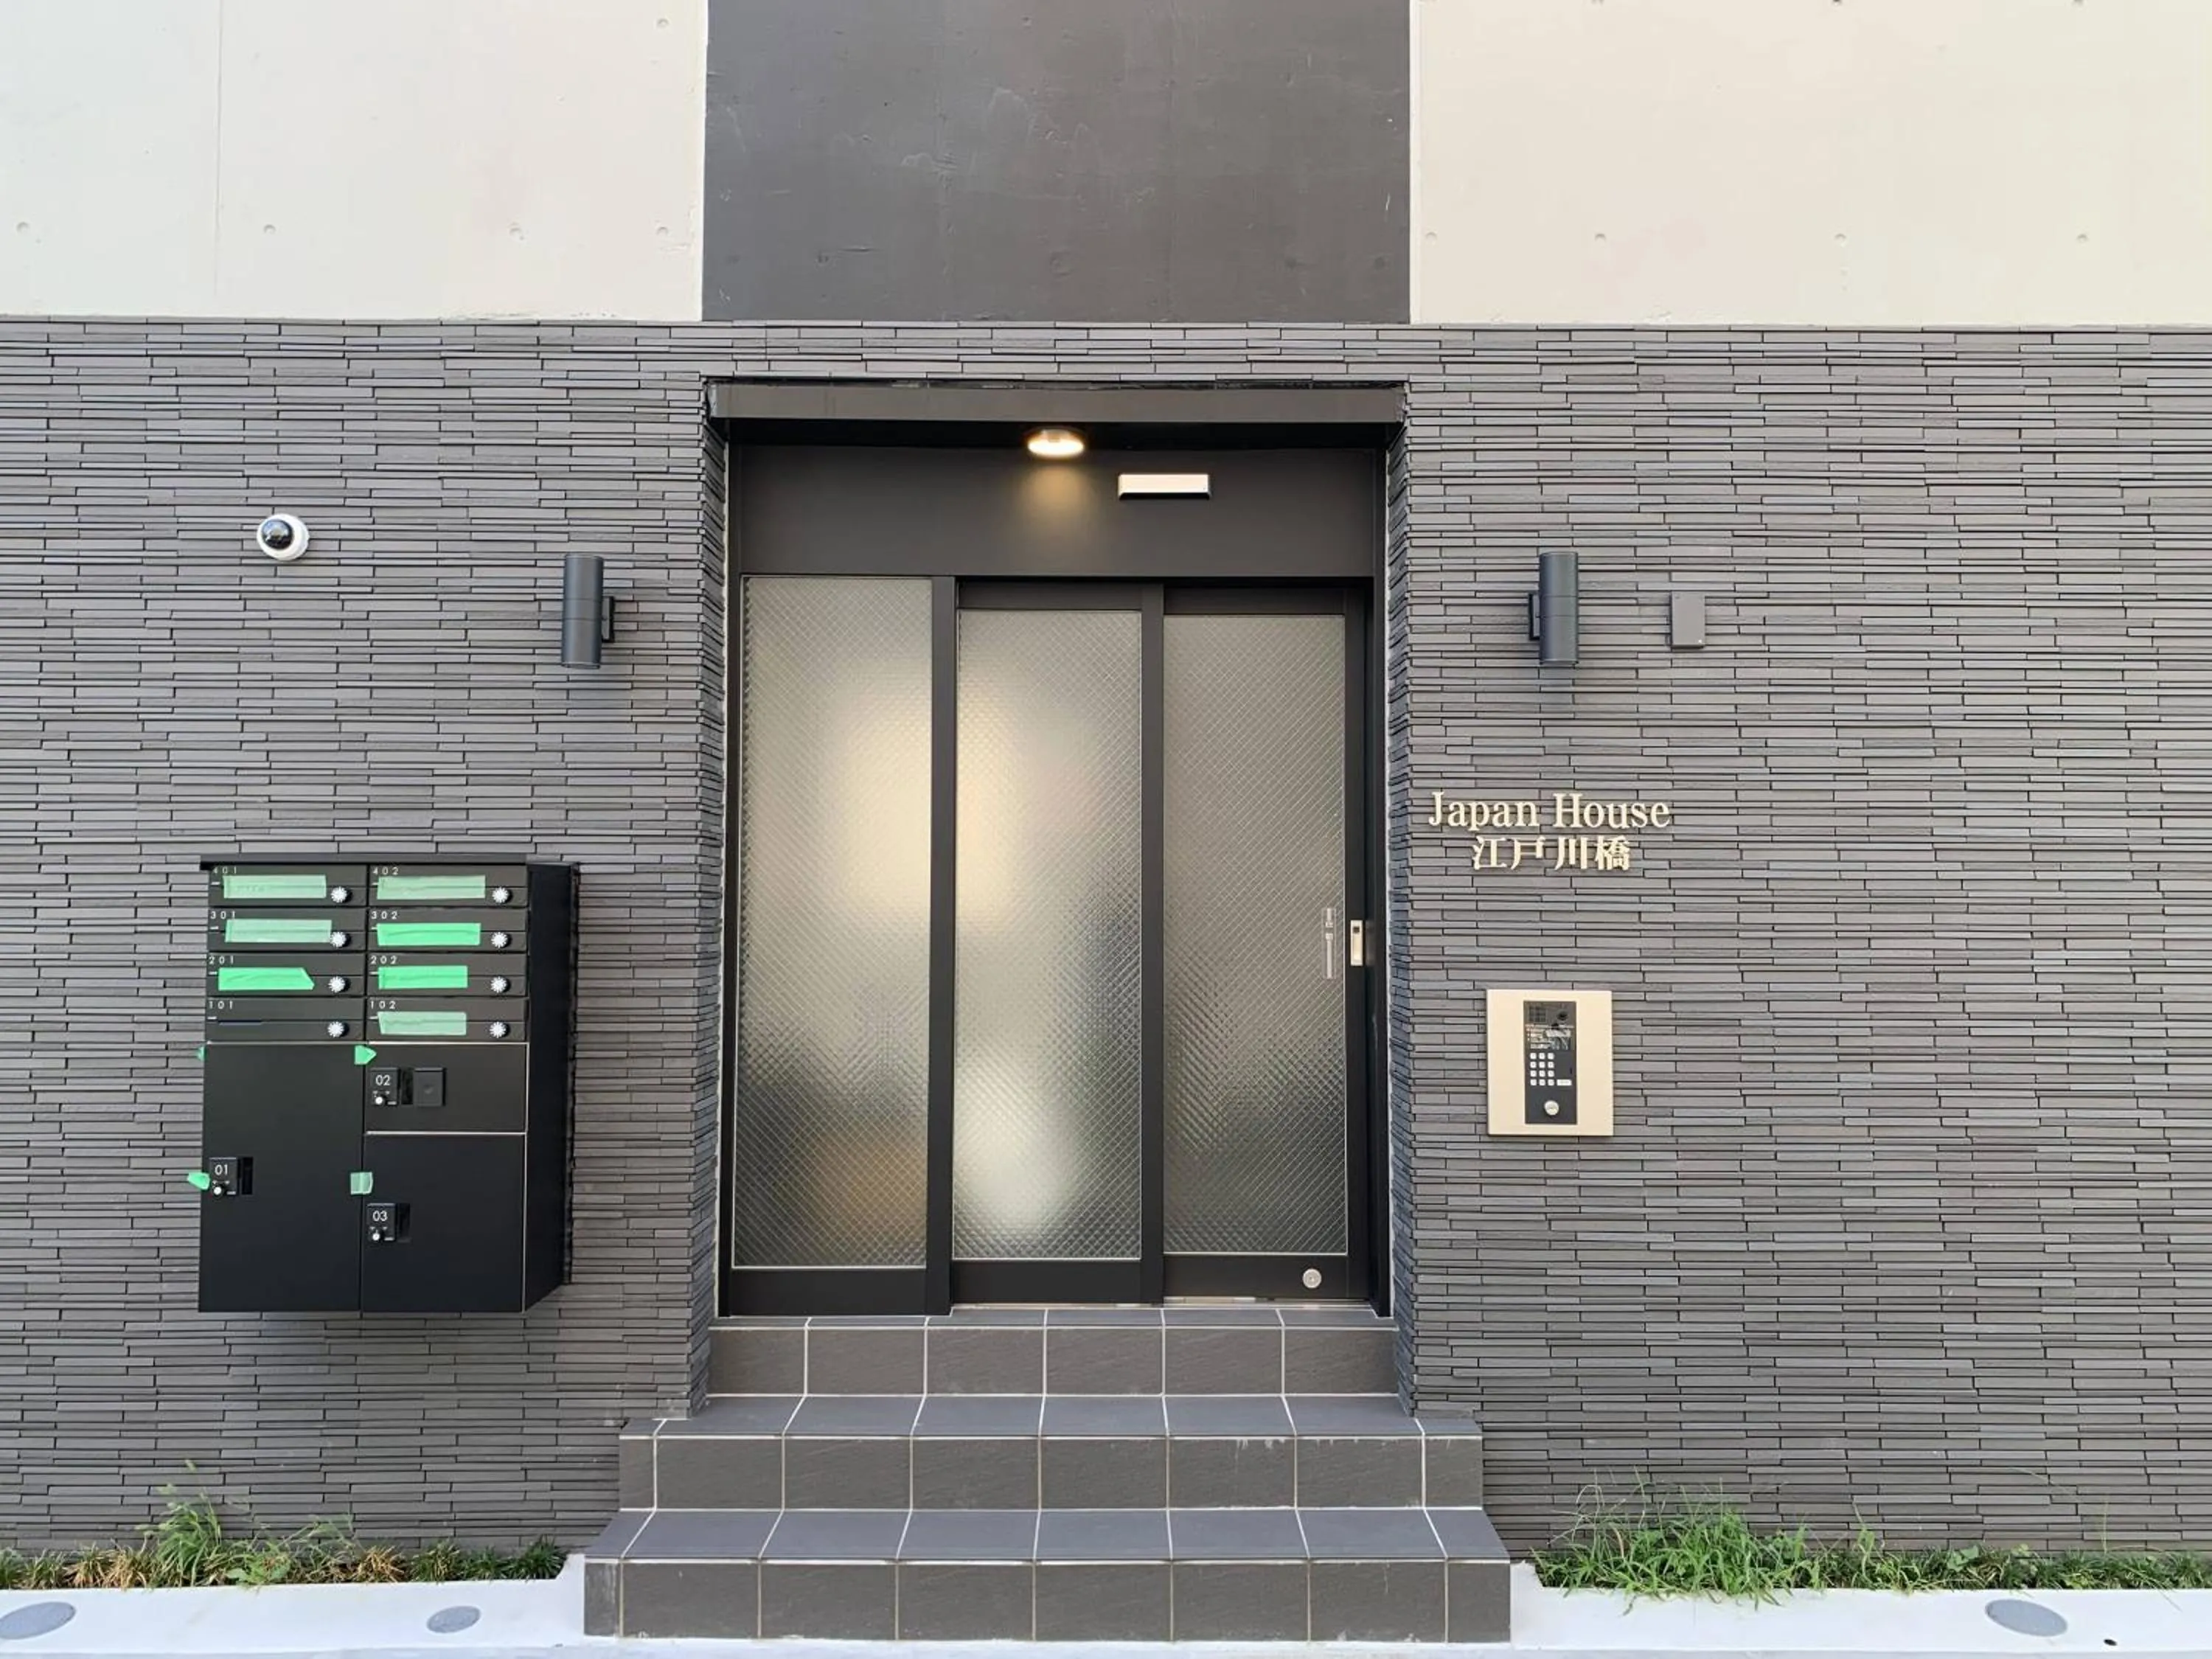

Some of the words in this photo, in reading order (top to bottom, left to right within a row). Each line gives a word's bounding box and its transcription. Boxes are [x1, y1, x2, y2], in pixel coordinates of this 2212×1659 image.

[1428, 792, 1540, 830] Japan
[1552, 793, 1670, 829] House
[1472, 835, 1631, 871] 江戸川橋
[213, 866, 237, 874] 401
[372, 866, 399, 875] 402
[210, 911, 236, 919] 301
[371, 911, 399, 920] 302
[209, 956, 234, 964] 201
[371, 956, 397, 964] 202
[209, 1001, 233, 1009] 101
[370, 1001, 397, 1009] 102
[375, 1075, 391, 1086] 02
[215, 1164, 229, 1175] 01
[372, 1211, 387, 1222] 03
